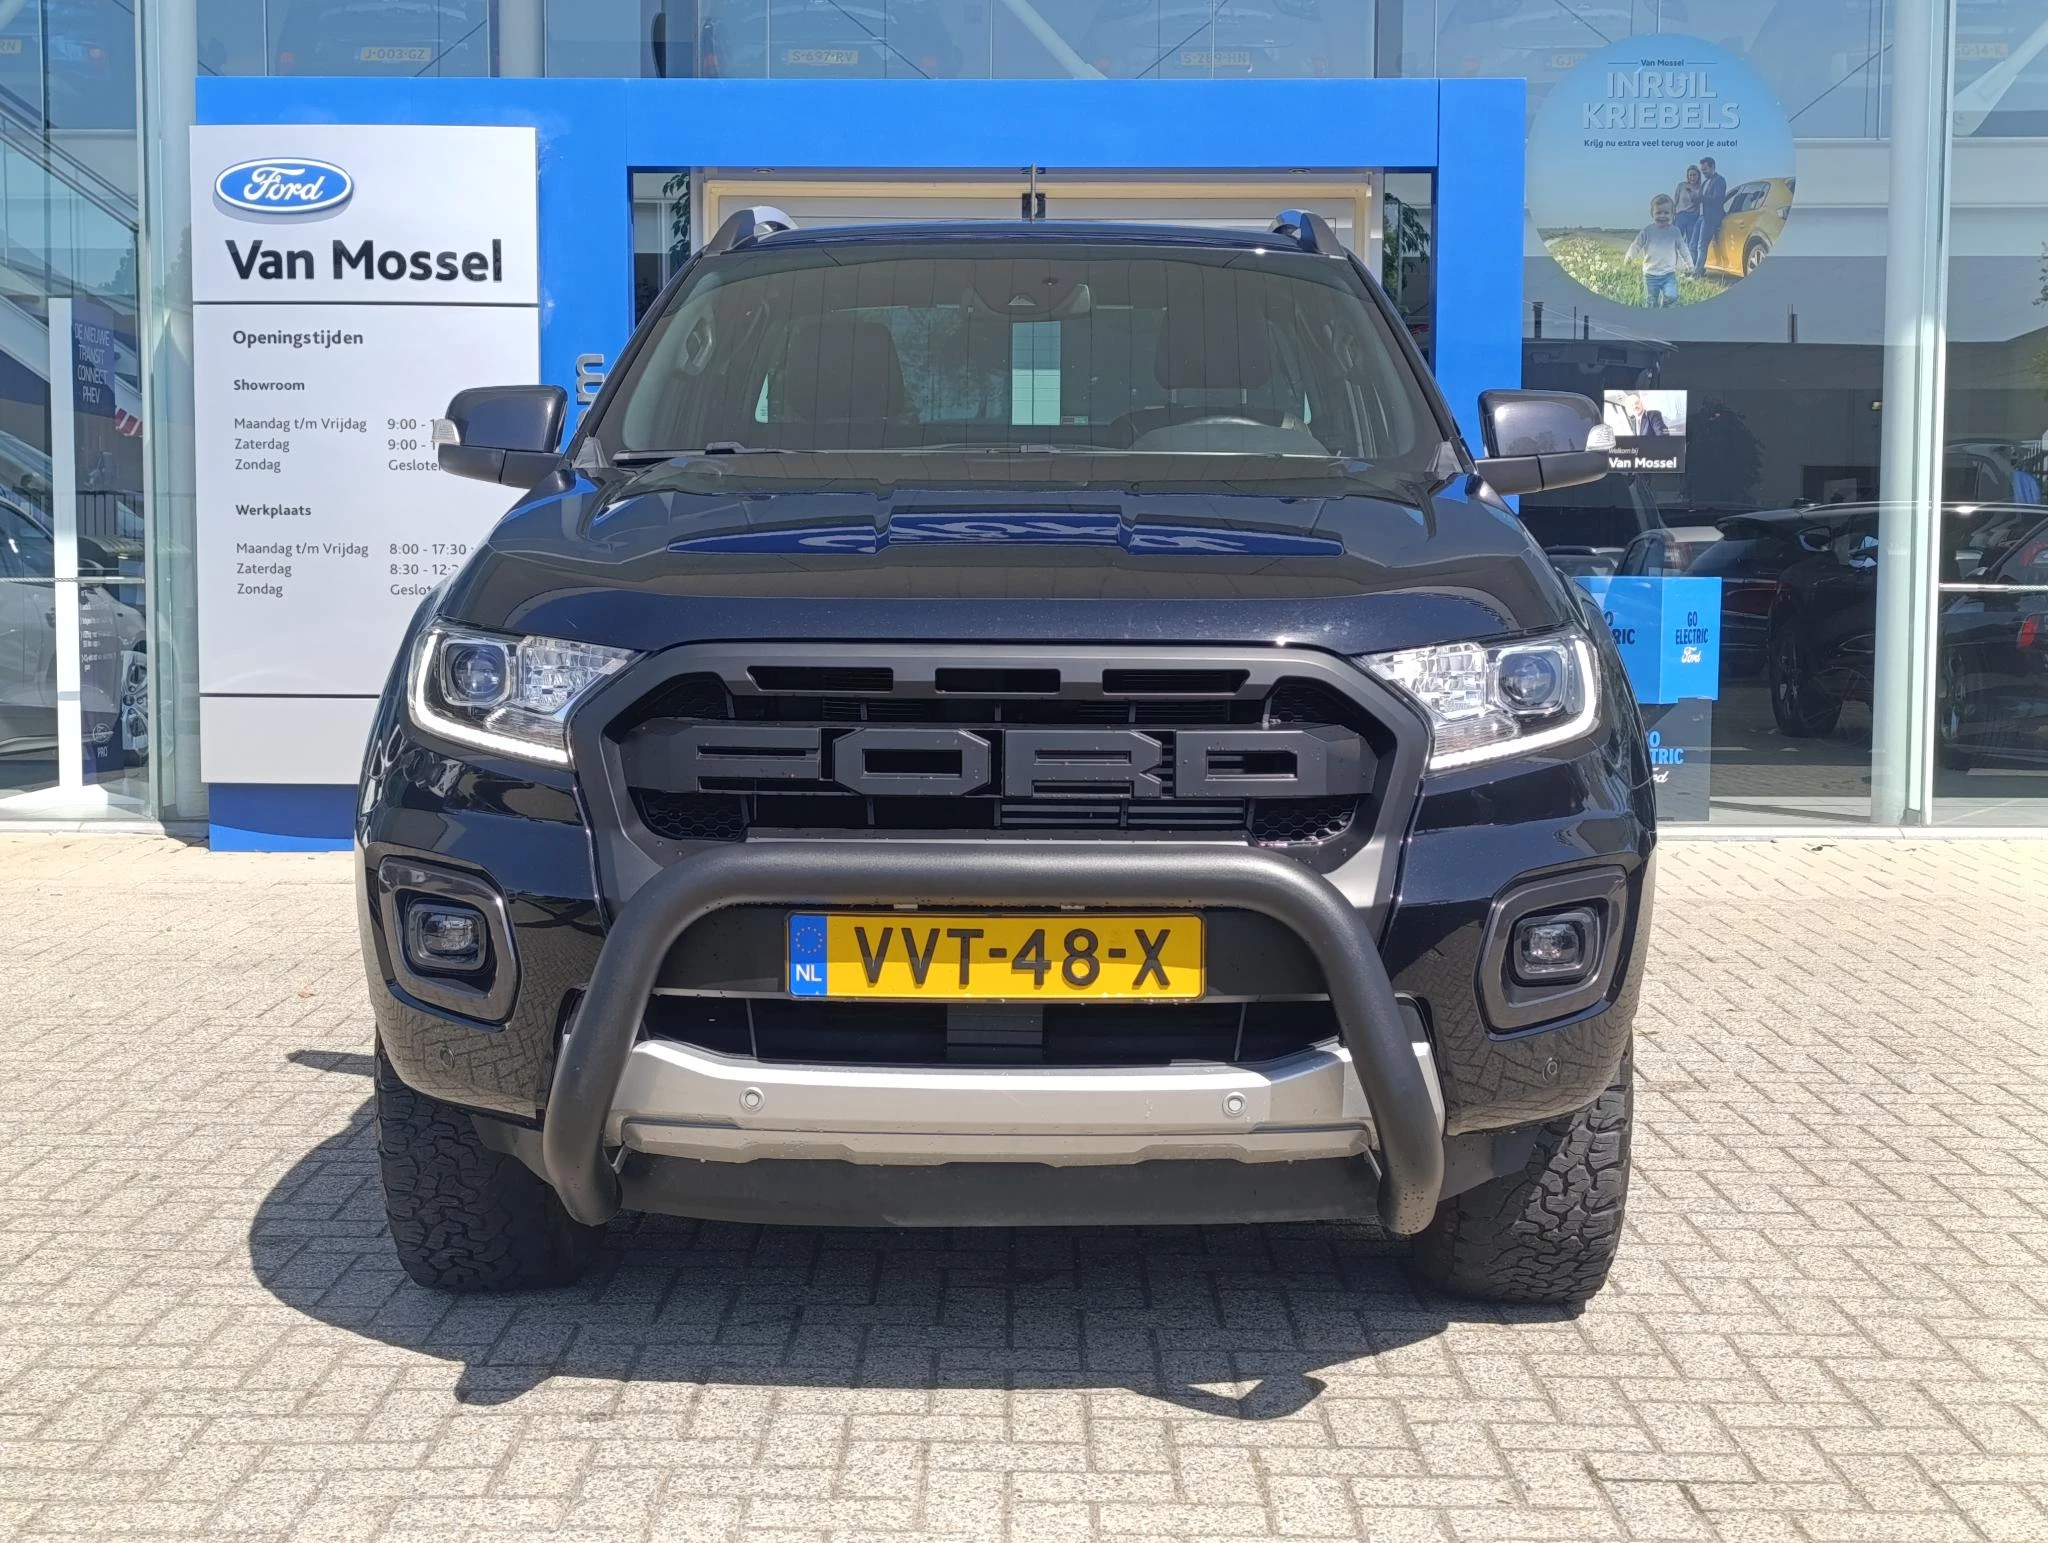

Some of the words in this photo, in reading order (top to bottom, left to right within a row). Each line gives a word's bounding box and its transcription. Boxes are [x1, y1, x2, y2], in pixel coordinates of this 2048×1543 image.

[1640, 58, 1655, 67] Van
[1656, 58, 1685, 67] Mossel
[1606, 71, 1718, 99] INRUIL
[1582, 102, 1741, 130] KRIEBELS
[1583, 138, 1604, 149] Krijg
[1617, 139, 1640, 147] extra
[1641, 138, 1660, 147] veel
[1661, 139, 1684, 149] terug
[1706, 138, 1715, 149] je
[1716, 139, 1738, 147] auto!
[243, 165, 326, 201] Ford
[224, 239, 315, 280] Van
[332, 238, 503, 283] Mossel
[74, 323, 83, 341] DE
[83, 324, 110, 346] NIEUWE
[232, 329, 364, 349] Openingstijden
[78, 344, 105, 365] TRANSIT
[77, 364, 108, 386] CONNECT
[233, 378, 305, 391] Showroom
[82, 385, 101, 405] PHEV
[234, 417, 291, 433] Maandag
[294, 417, 317, 430] t/m
[321, 417, 367, 433] Vrijdag
[387, 418, 417, 430] 9:00
[234, 437, 290, 453] Zaterdag
[387, 438, 417, 450] 9:00
[1608, 447, 1631, 455] Welkom
[1631, 446, 1640, 456] bij
[234, 458, 281, 473] Zondag
[1609, 457, 1632, 469] Van
[1634, 456, 1677, 469] Mossel
[235, 503, 312, 519] Werkplaats
[236, 542, 293, 557] Maandag
[296, 542, 319, 555] t/m
[323, 542, 369, 557] Vrijdag
[389, 543, 419, 555] 8:00
[431, 543, 467, 555] 17:30
[236, 562, 292, 578] Zaterdag
[390, 563, 419, 575] 8:30
[237, 583, 283, 598] Zondag
[1686, 611, 1698, 627] GO
[1675, 628, 1709, 645] ELECTRIC
[1681, 646, 1702, 664] Ford
[622, 724, 1376, 798] FORD
[853, 926, 1172, 988] VVT-48-X
[795, 965, 822, 982] NL
